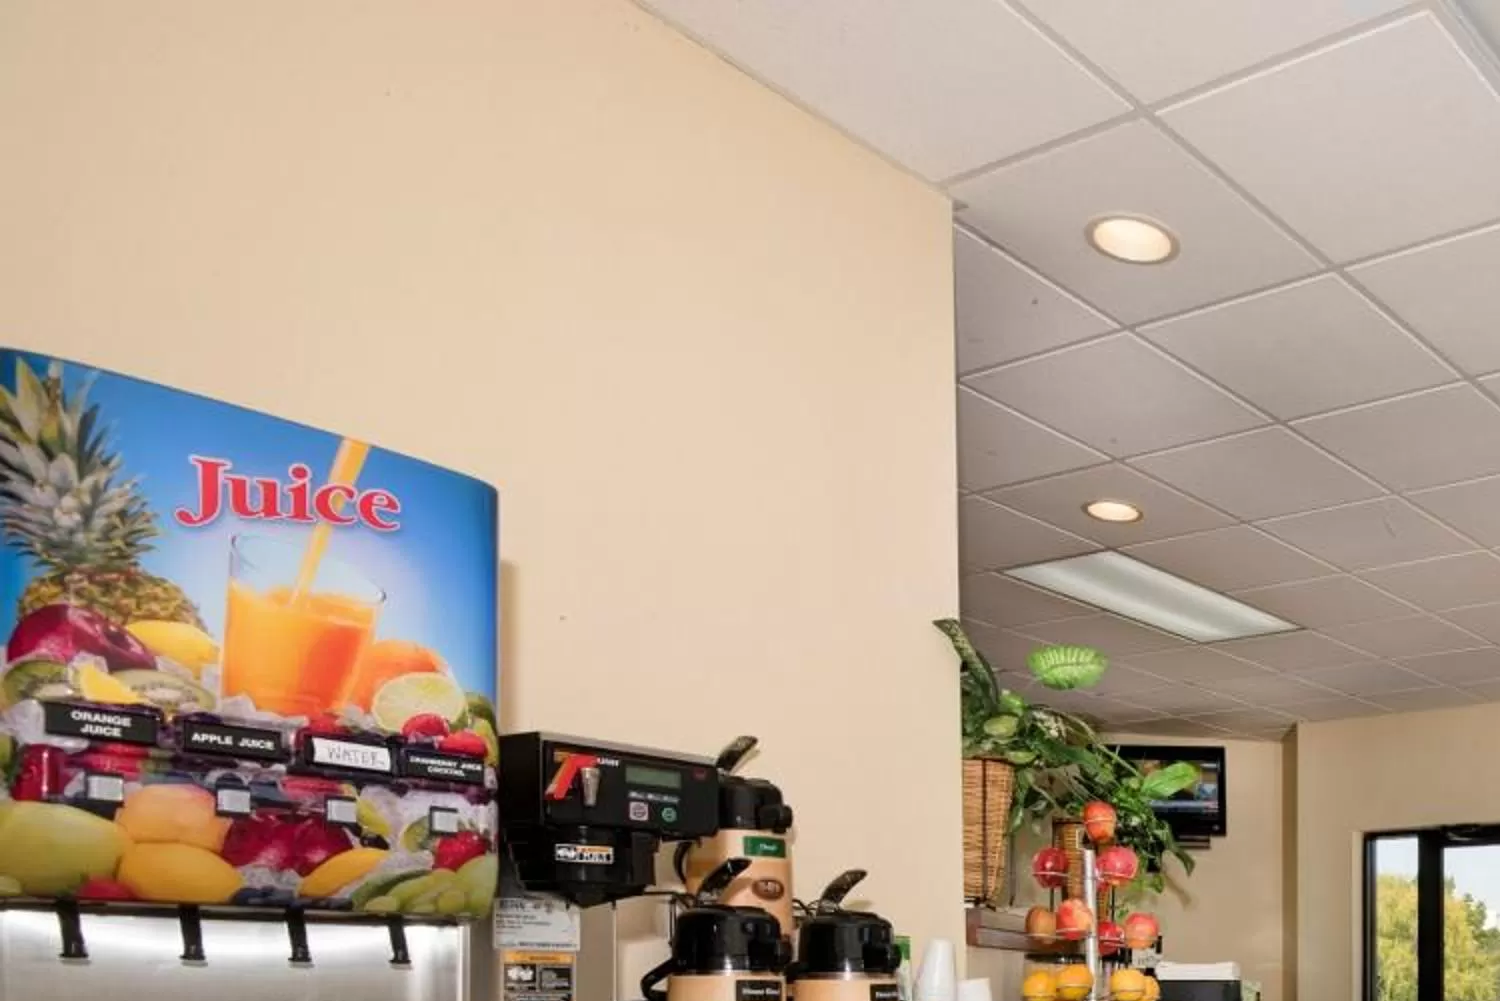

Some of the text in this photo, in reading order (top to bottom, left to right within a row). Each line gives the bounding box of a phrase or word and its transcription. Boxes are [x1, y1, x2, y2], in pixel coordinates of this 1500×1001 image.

[174, 454, 401, 532] Juice
[71, 710, 132, 728] ORANGE
[80, 723, 122, 738] JUICE
[191, 732, 275, 751] APPLE JUICE
